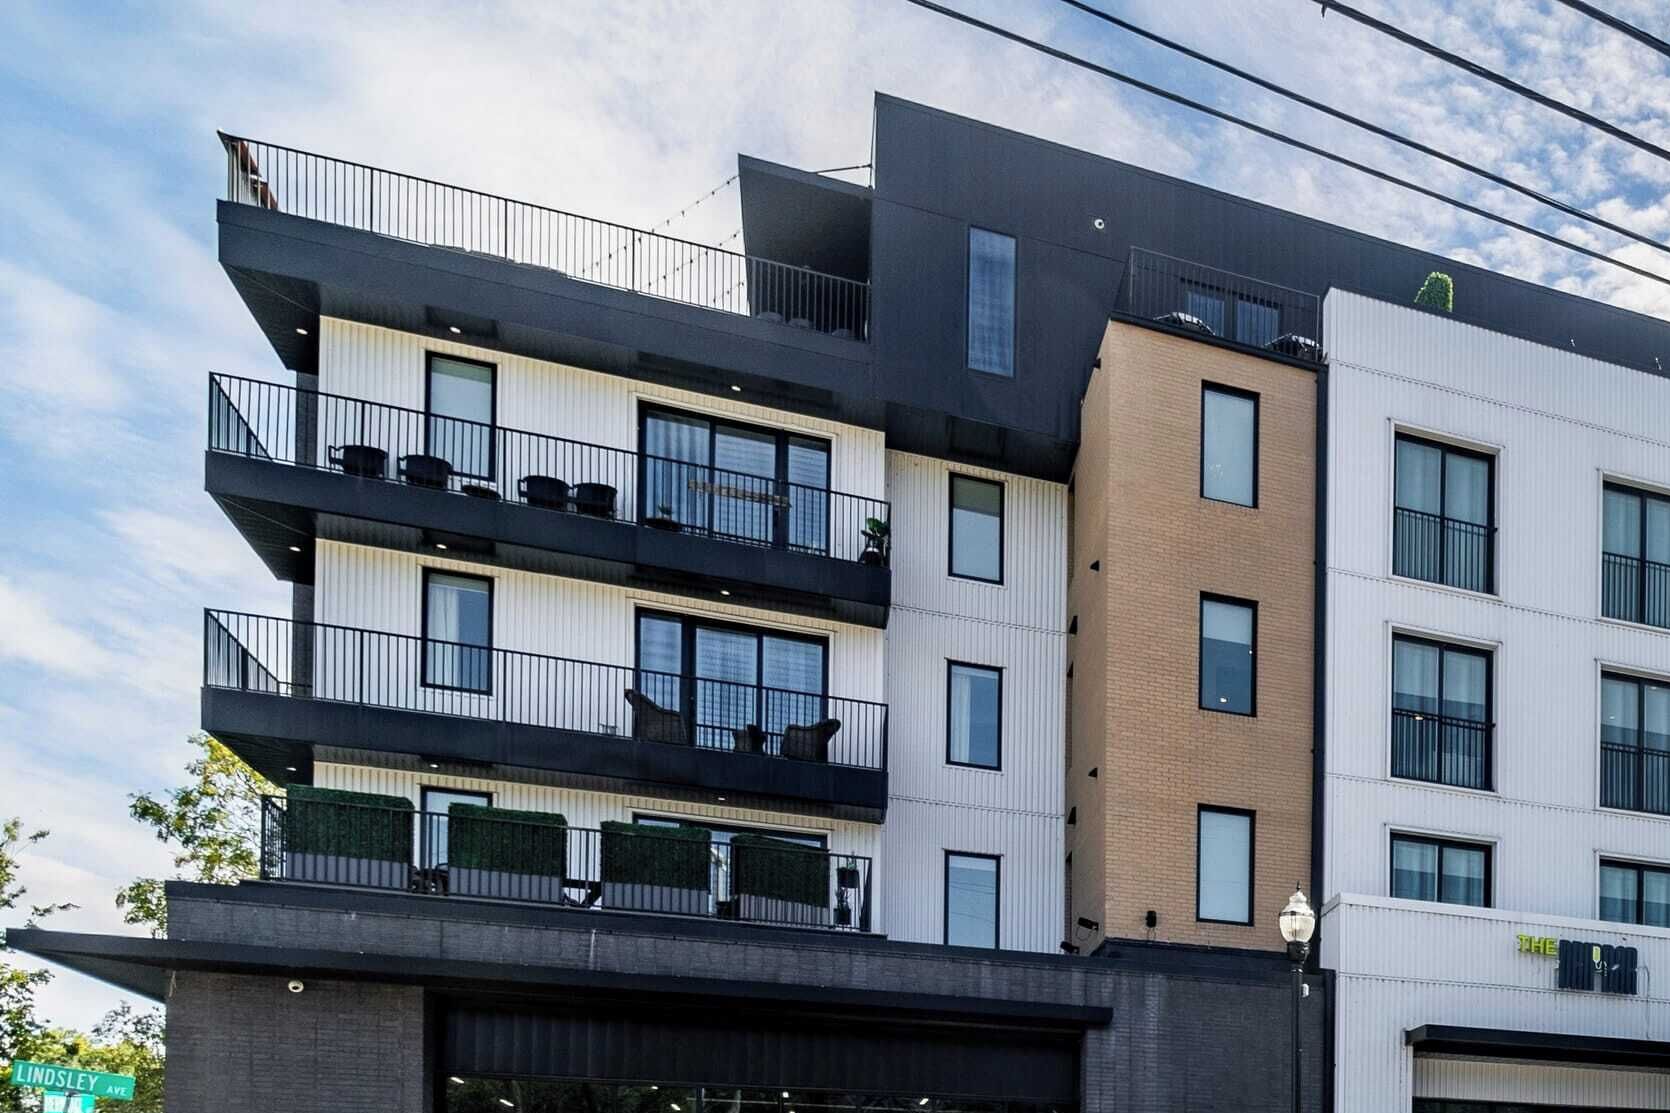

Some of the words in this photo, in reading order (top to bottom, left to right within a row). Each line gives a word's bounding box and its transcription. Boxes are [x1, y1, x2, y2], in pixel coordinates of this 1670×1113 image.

[1517, 934, 1557, 956] THE
[16, 1064, 98, 1091] LINDSLEY
[106, 1085, 127, 1097] AVE
